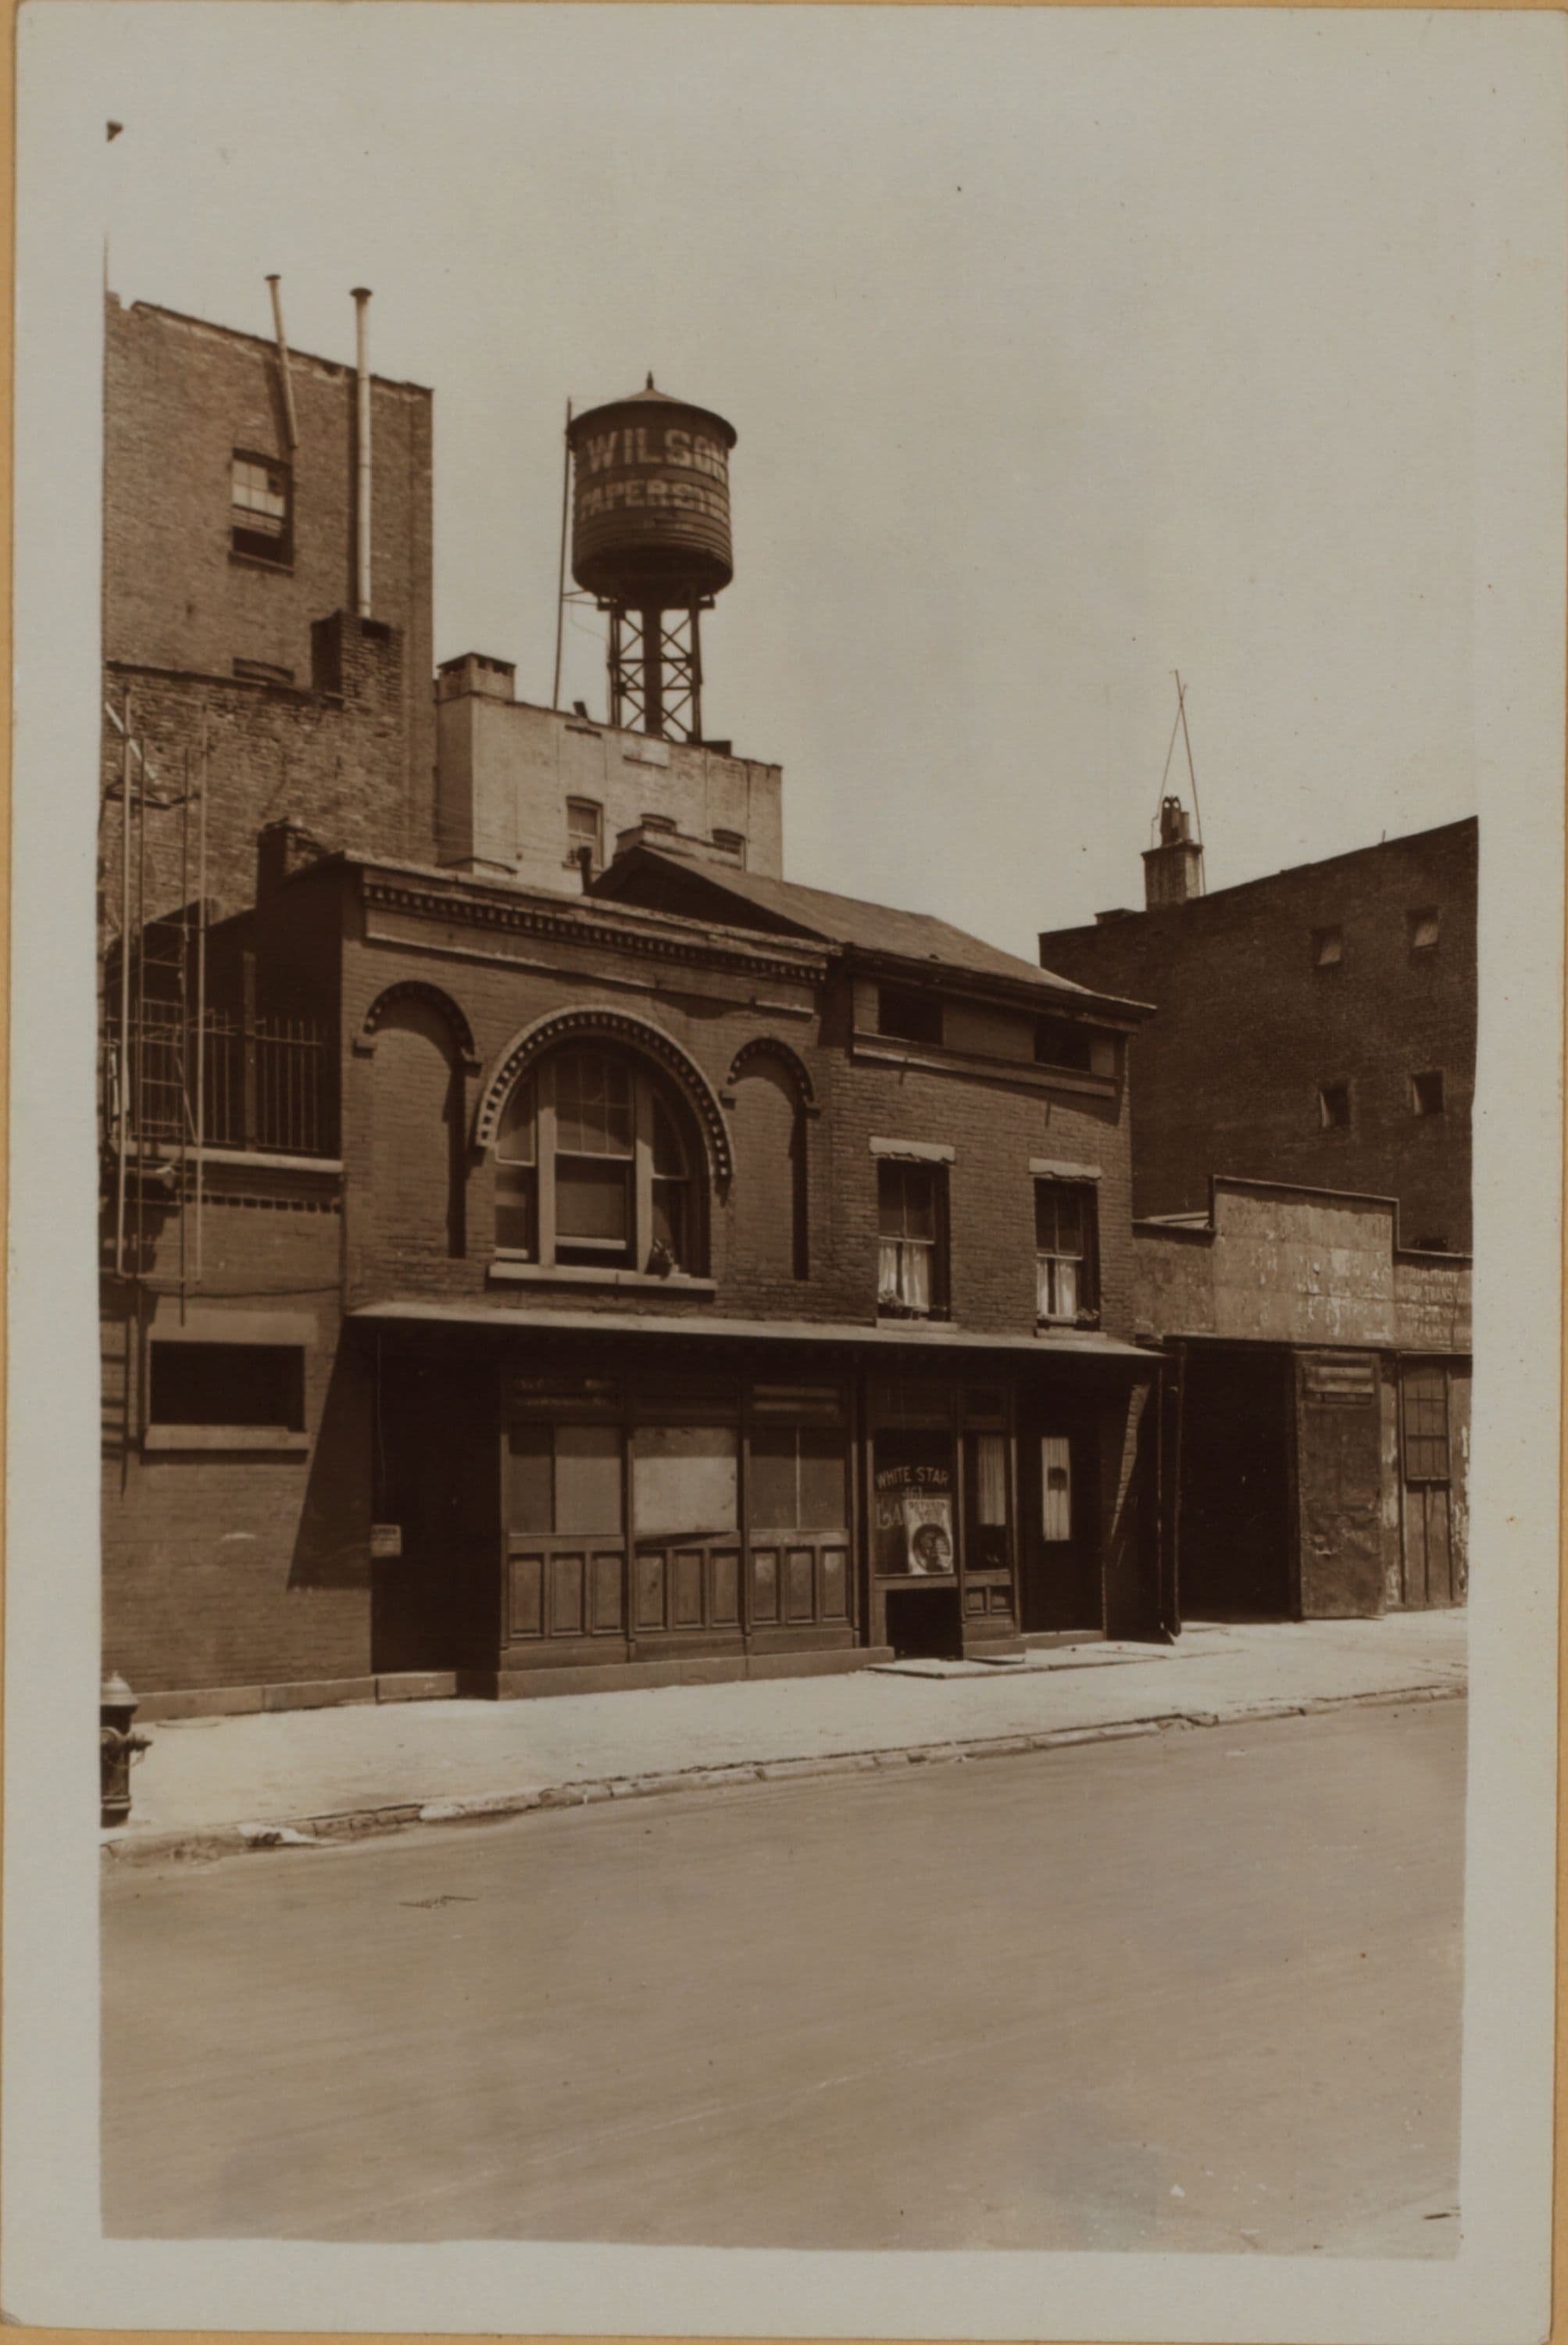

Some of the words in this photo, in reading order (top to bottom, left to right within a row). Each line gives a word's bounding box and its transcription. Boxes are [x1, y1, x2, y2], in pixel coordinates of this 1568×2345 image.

[586, 427, 727, 482] WILSON
[876, 1466, 911, 1489] WHITE
[916, 1466, 950, 1487] STAR
